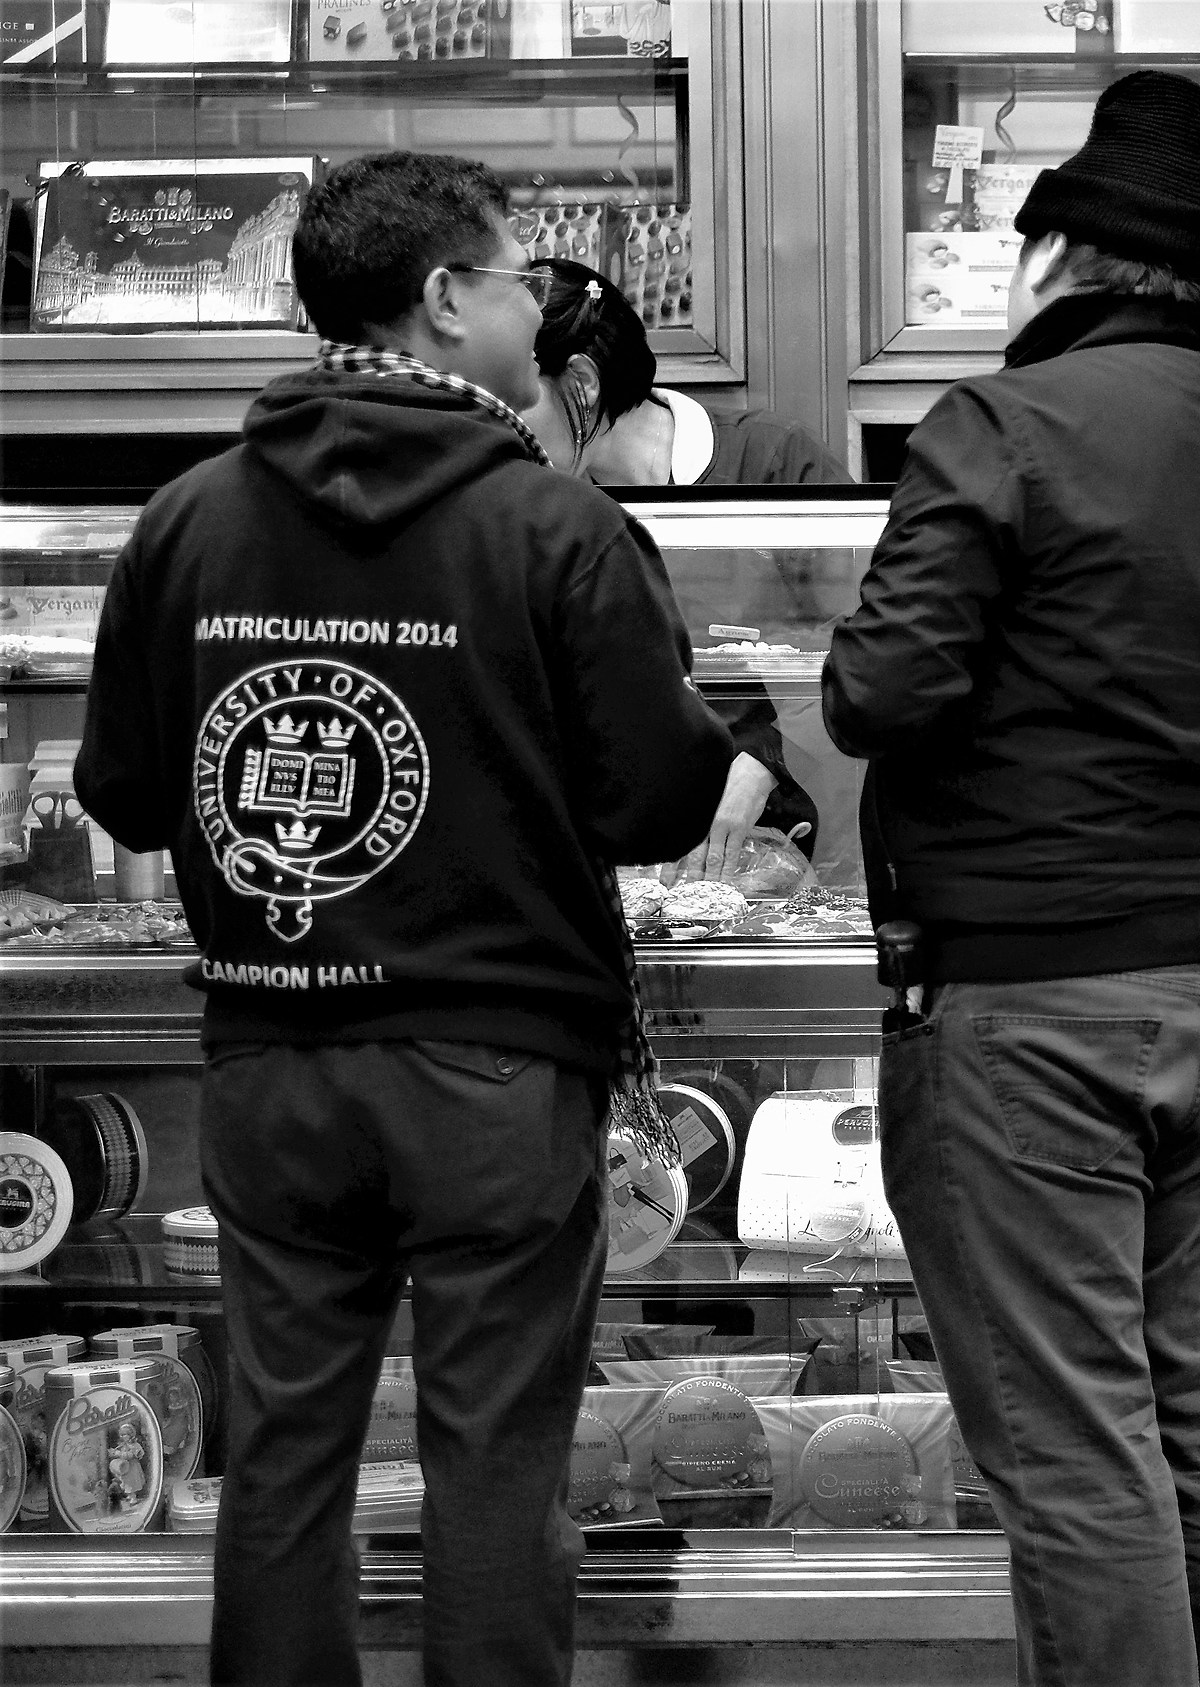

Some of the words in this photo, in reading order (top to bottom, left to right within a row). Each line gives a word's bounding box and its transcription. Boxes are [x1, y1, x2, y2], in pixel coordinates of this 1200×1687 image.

[0, 21, 19, 30] GE
[27, 597, 99, 615] Vergani
[195, 617, 390, 644] MATRICULATION
[395, 621, 459, 648] 2014
[199, 668, 303, 841] UNIVERSITY
[329, 672, 378, 706] OF
[365, 719, 420, 856] OXFORD
[271, 757, 304, 770] DOMI
[201, 958, 310, 990] CAMPION
[317, 964, 391, 987] HALL
